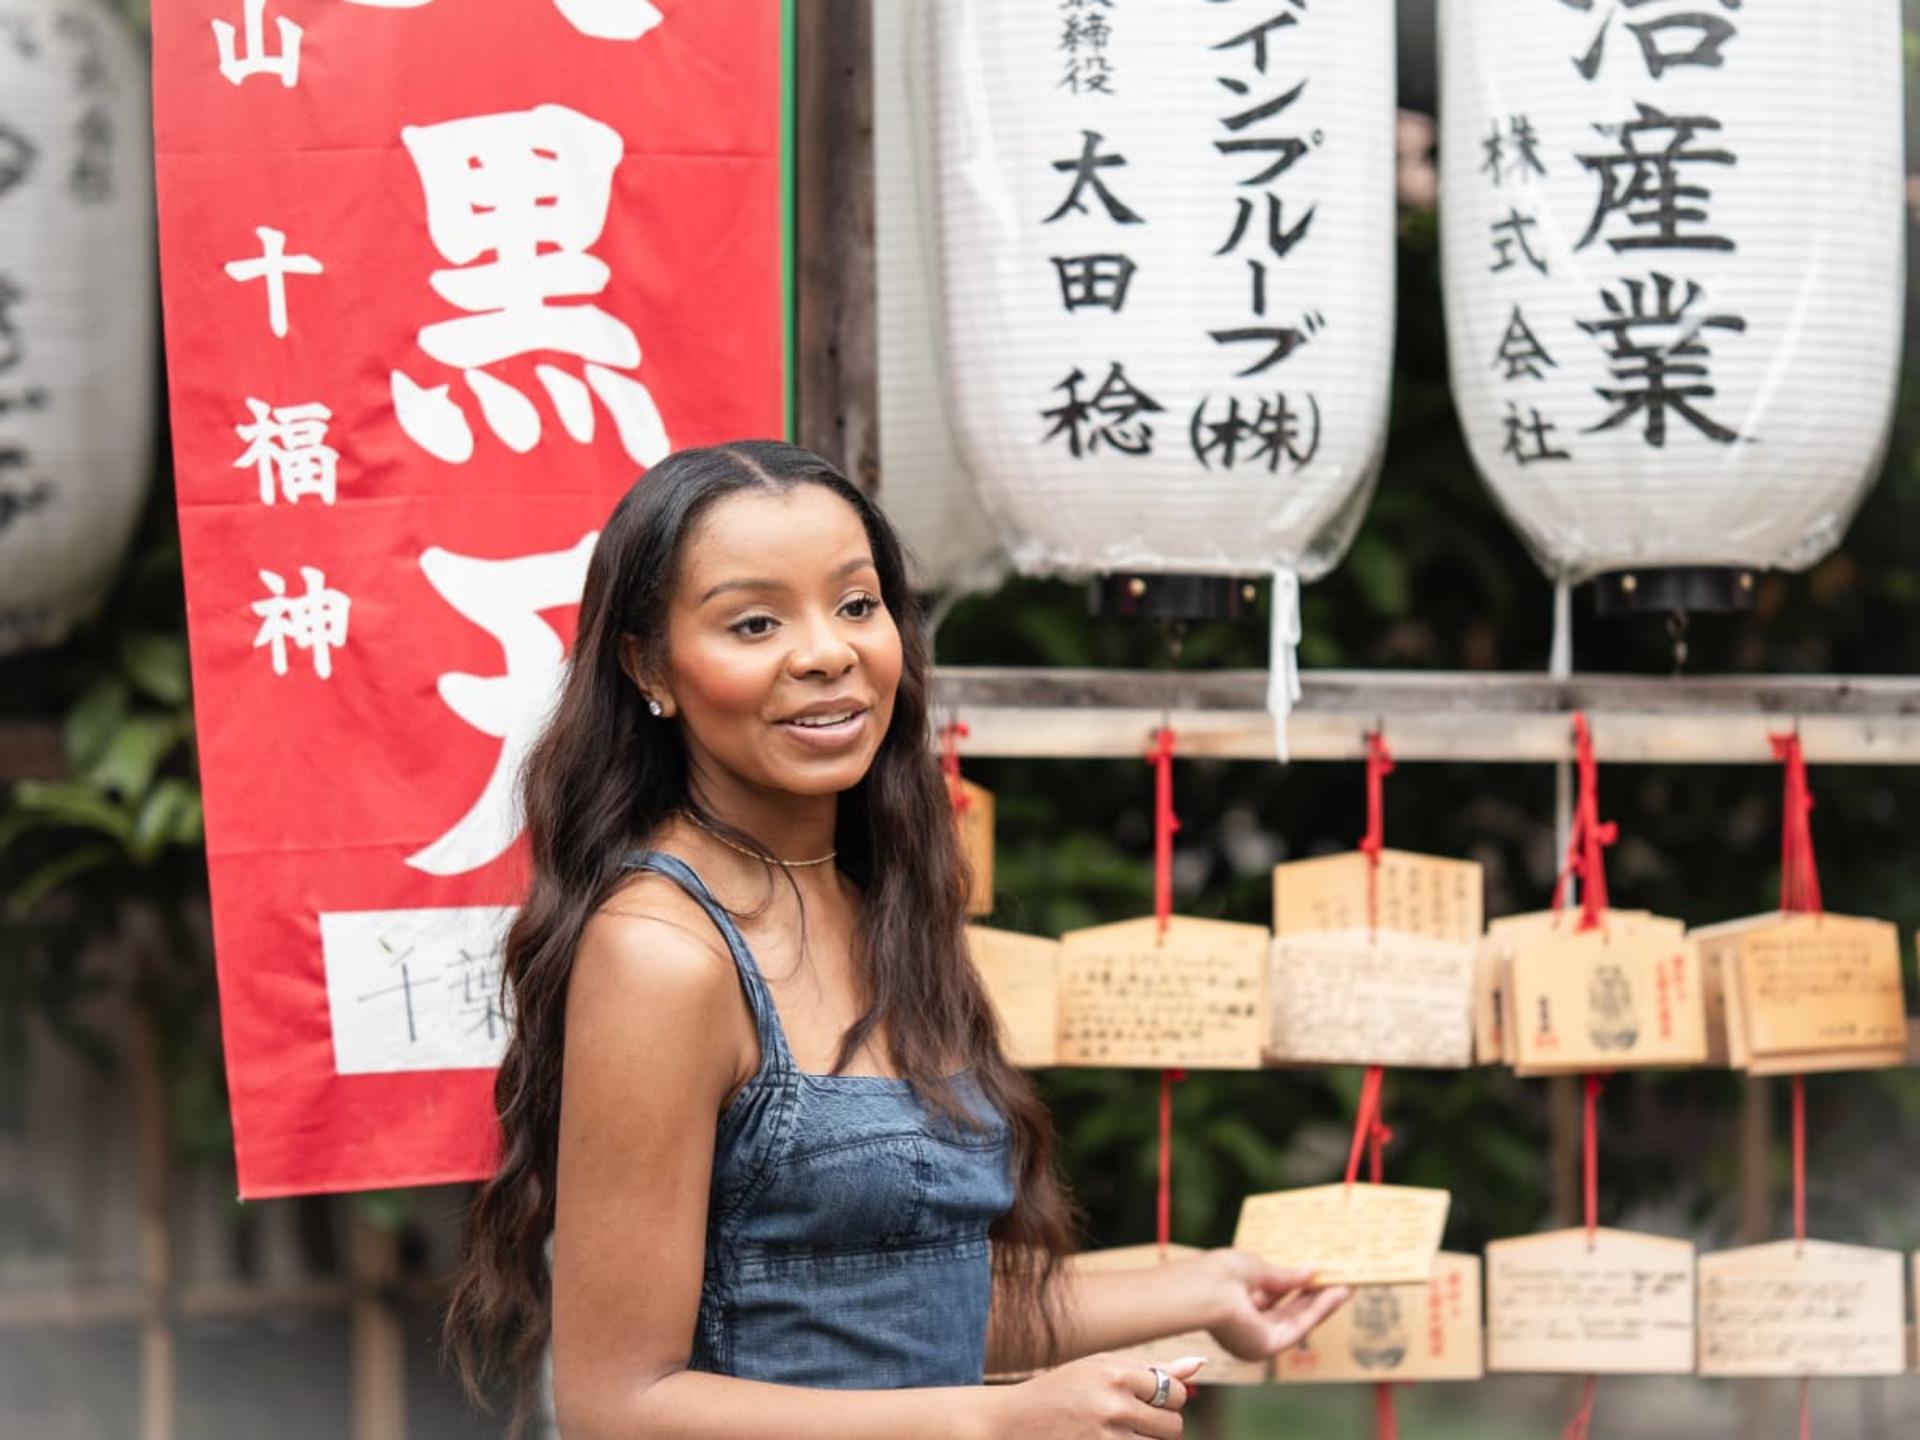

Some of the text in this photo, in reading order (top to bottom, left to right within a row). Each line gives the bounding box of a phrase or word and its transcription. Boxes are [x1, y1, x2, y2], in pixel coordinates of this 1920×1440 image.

[1054, 0, 1118, 96] 締役
[1190, 0, 1327, 473] インプルーブ(株)
[1481, 114, 1571, 466] 株式会社
